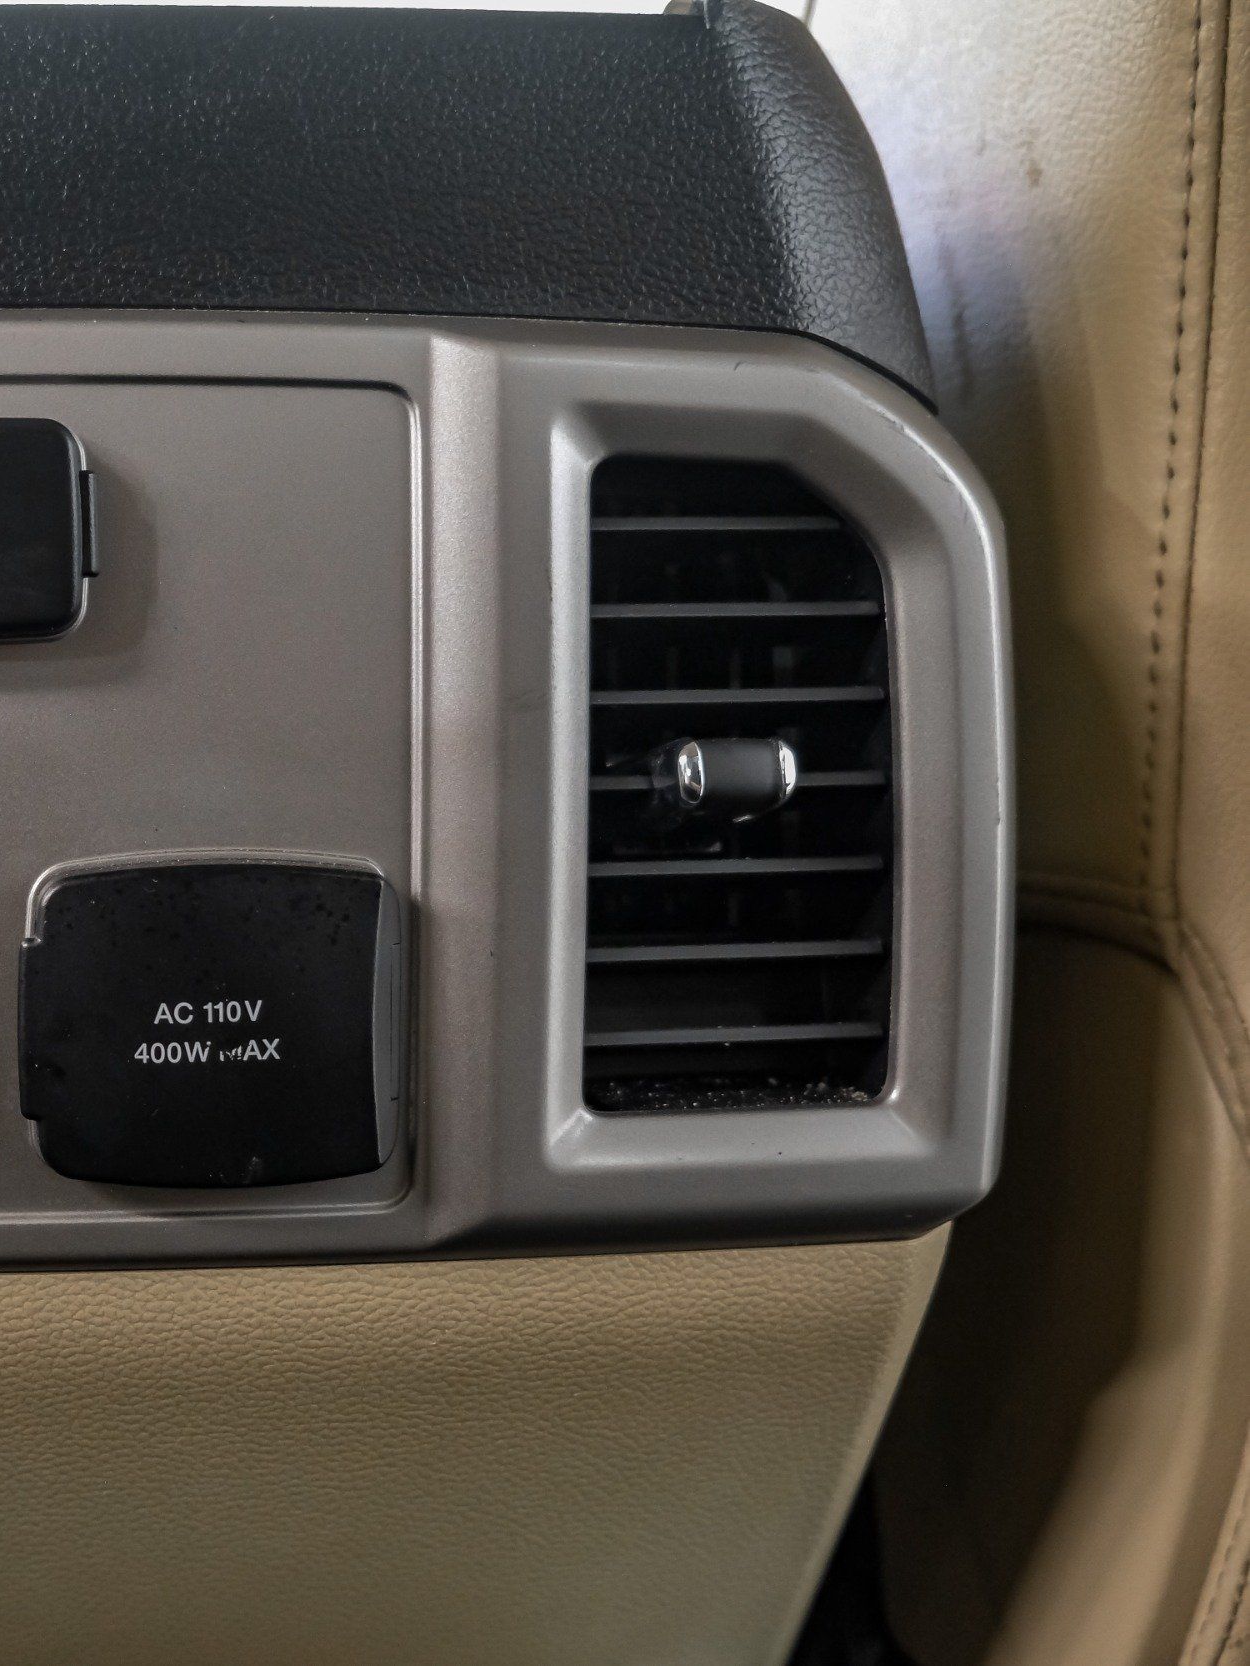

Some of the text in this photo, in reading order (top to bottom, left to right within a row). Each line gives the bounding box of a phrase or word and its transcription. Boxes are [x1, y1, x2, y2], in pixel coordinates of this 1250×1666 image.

[153, 999, 263, 1025] AC 110V
[134, 1041, 212, 1064] 400W
